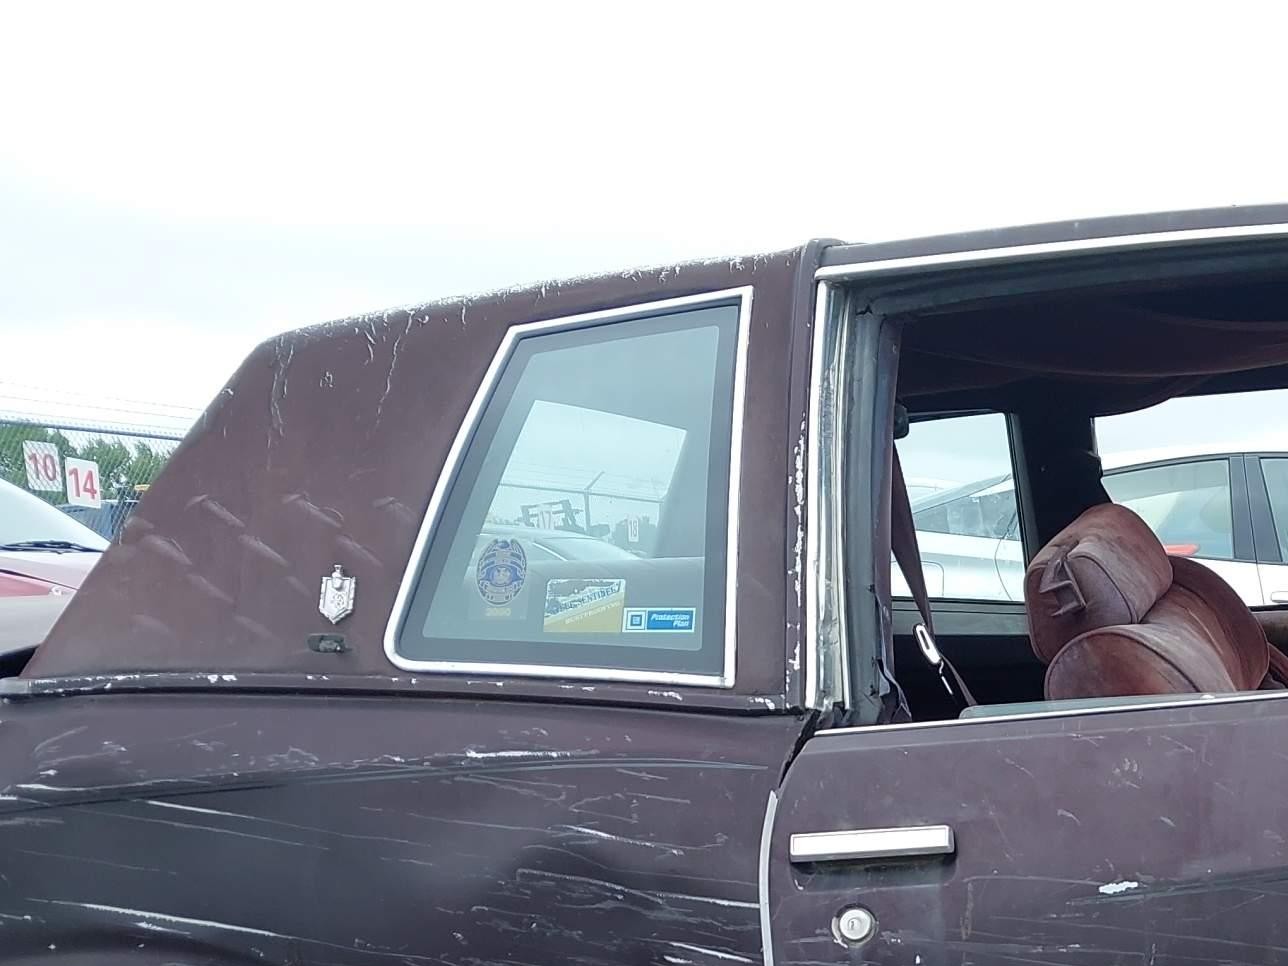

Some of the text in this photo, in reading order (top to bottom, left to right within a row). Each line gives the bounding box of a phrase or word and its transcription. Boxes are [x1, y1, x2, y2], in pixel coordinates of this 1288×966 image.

[28, 452, 58, 482] 10
[68, 467, 98, 500] 14
[650, 613, 690, 622] Protection
[672, 620, 689, 628] Plan
